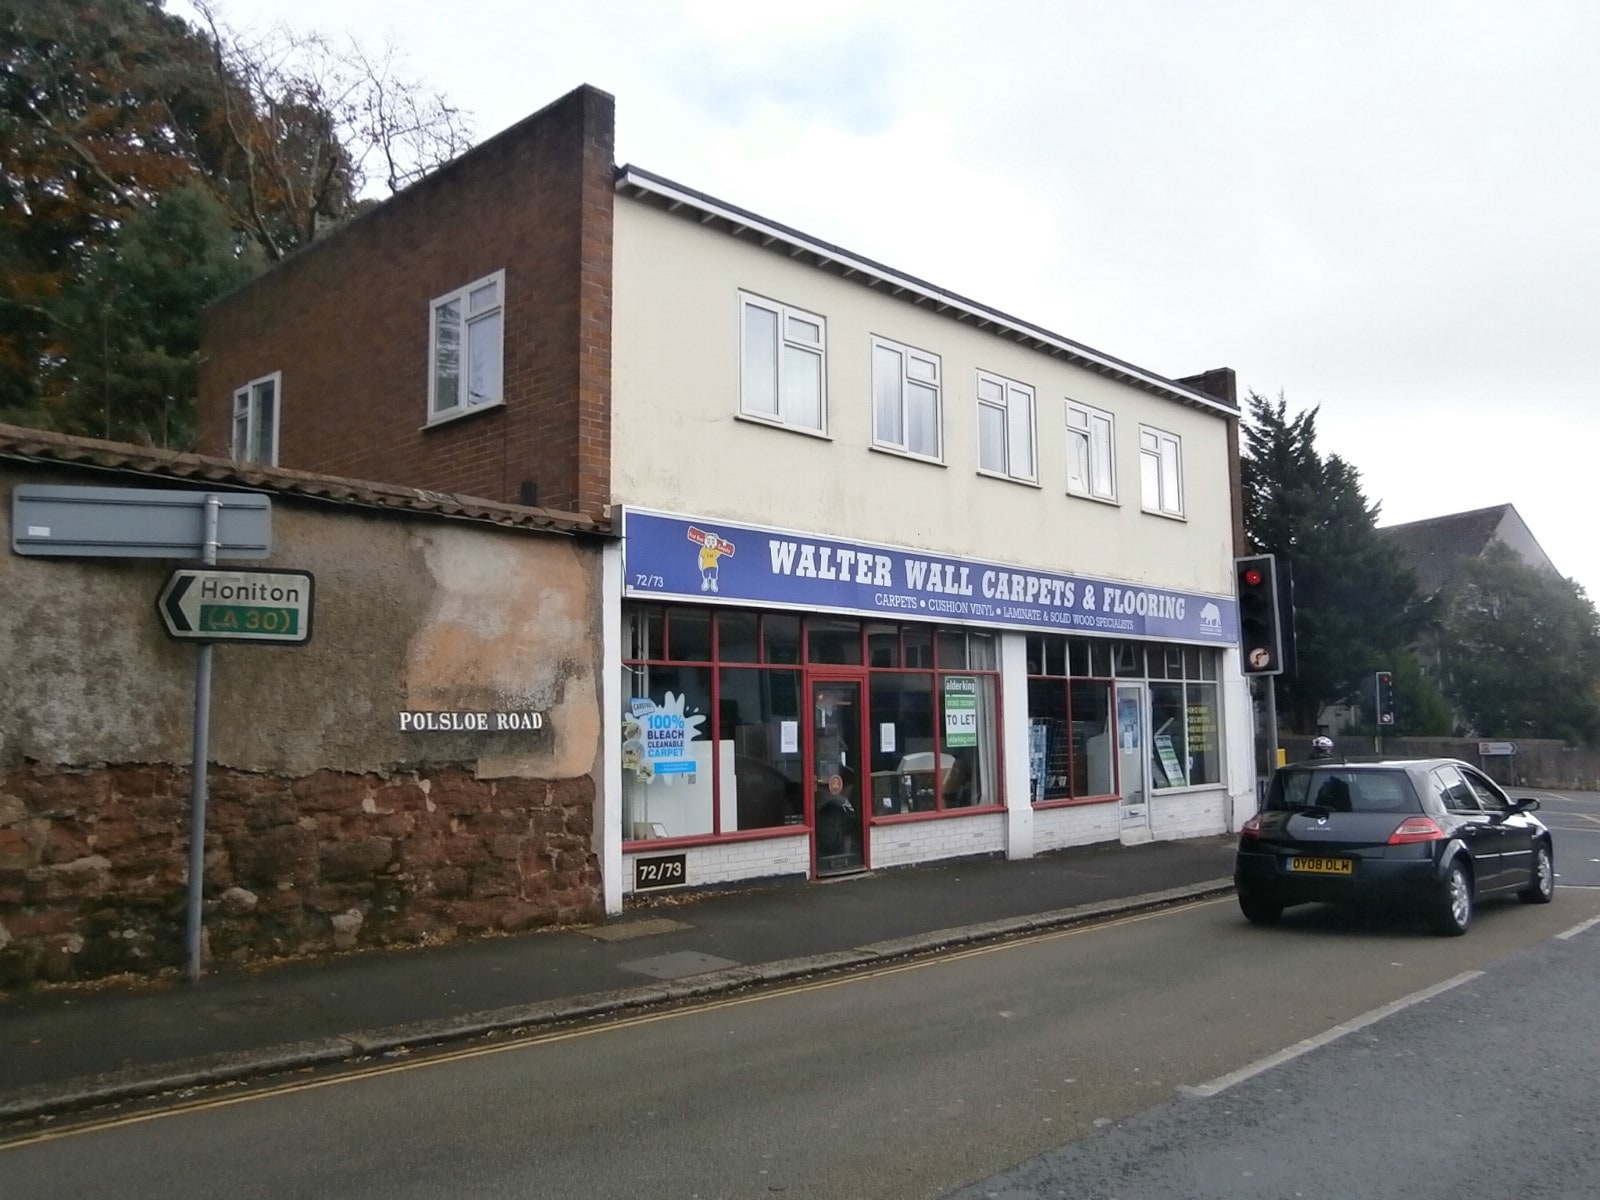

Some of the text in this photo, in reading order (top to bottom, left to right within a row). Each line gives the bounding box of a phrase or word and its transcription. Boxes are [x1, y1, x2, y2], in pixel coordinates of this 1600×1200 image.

[636, 574, 664, 588] 72/73
[769, 540, 1186, 621] WALTER WALL CARPETS & FLOORING
[201, 581, 299, 602] Honiton
[875, 593, 1134, 630] CARPETS CUSHION VINYL LAMINATE & SOLID WOOD SPECIALISTS
[246, 609, 290, 632] 30)
[946, 679, 975, 693] alder king
[400, 712, 542, 730] POLSLOE ROAD
[648, 715, 685, 729] 100%
[947, 714, 975, 725] TO LET
[647, 730, 685, 740] BLEACH
[648, 740, 684, 748] CLEANABLE
[648, 748, 684, 758] CARPET
[639, 862, 682, 880] 72/73
[1293, 858, 1322, 871] OY08
